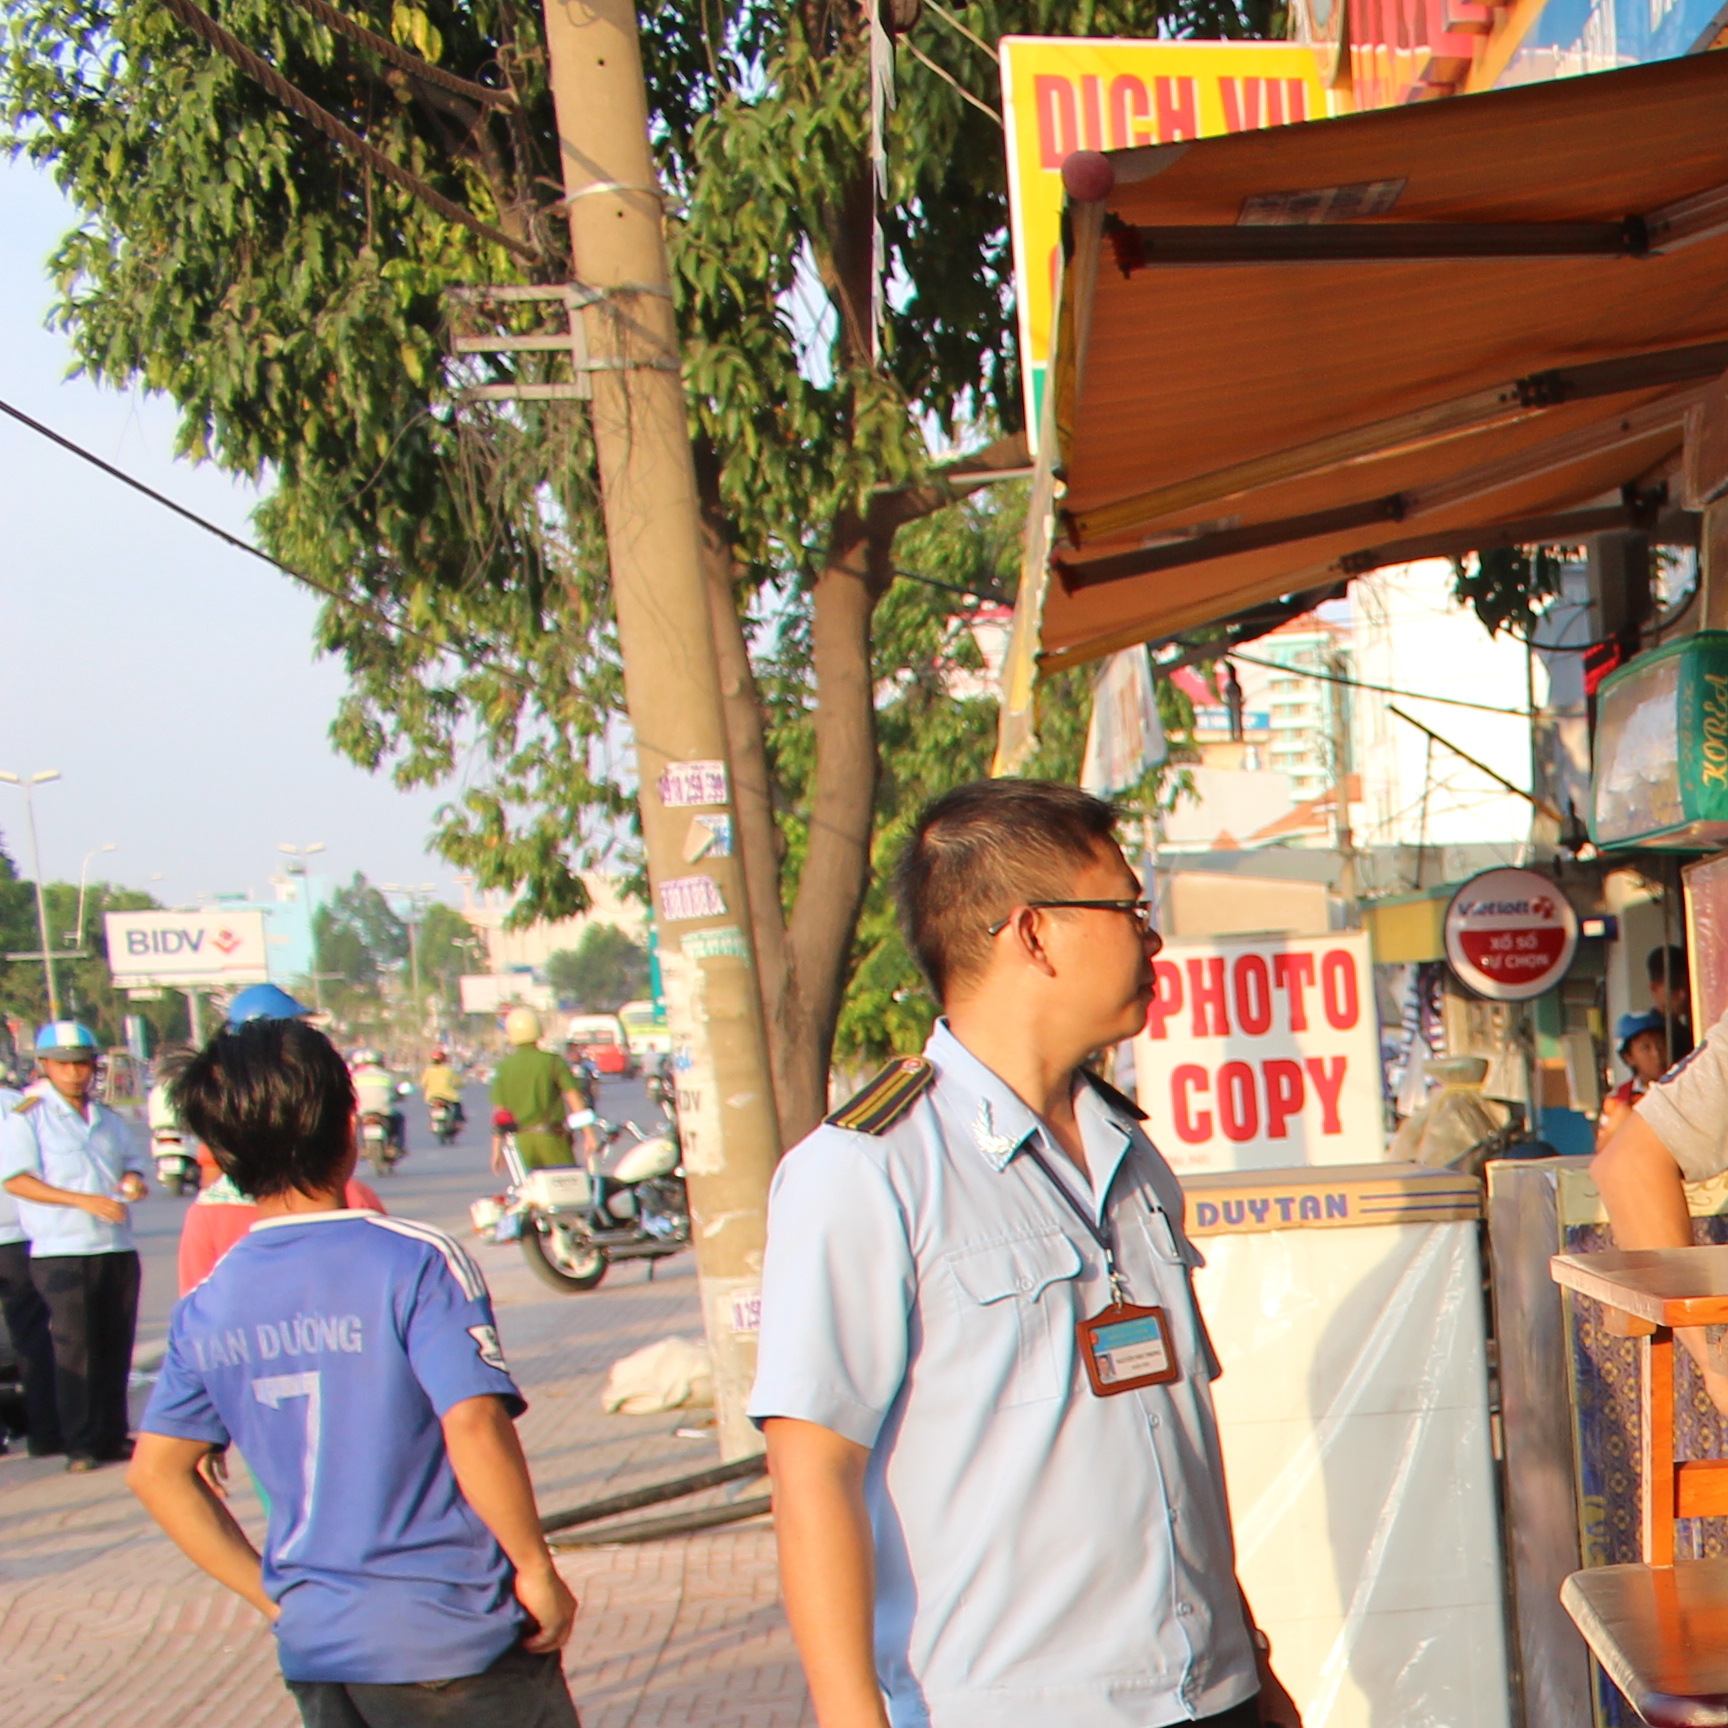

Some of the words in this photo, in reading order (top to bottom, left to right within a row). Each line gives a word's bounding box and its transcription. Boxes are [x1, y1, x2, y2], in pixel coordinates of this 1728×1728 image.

[125, 928, 205, 956] BIDV
[1149, 949, 1359, 1040] PHOTO
[1170, 1056, 1348, 1145] COPY
[1196, 1193, 1349, 1227] DUYTAN
[252, 1370, 322, 1561] 7
